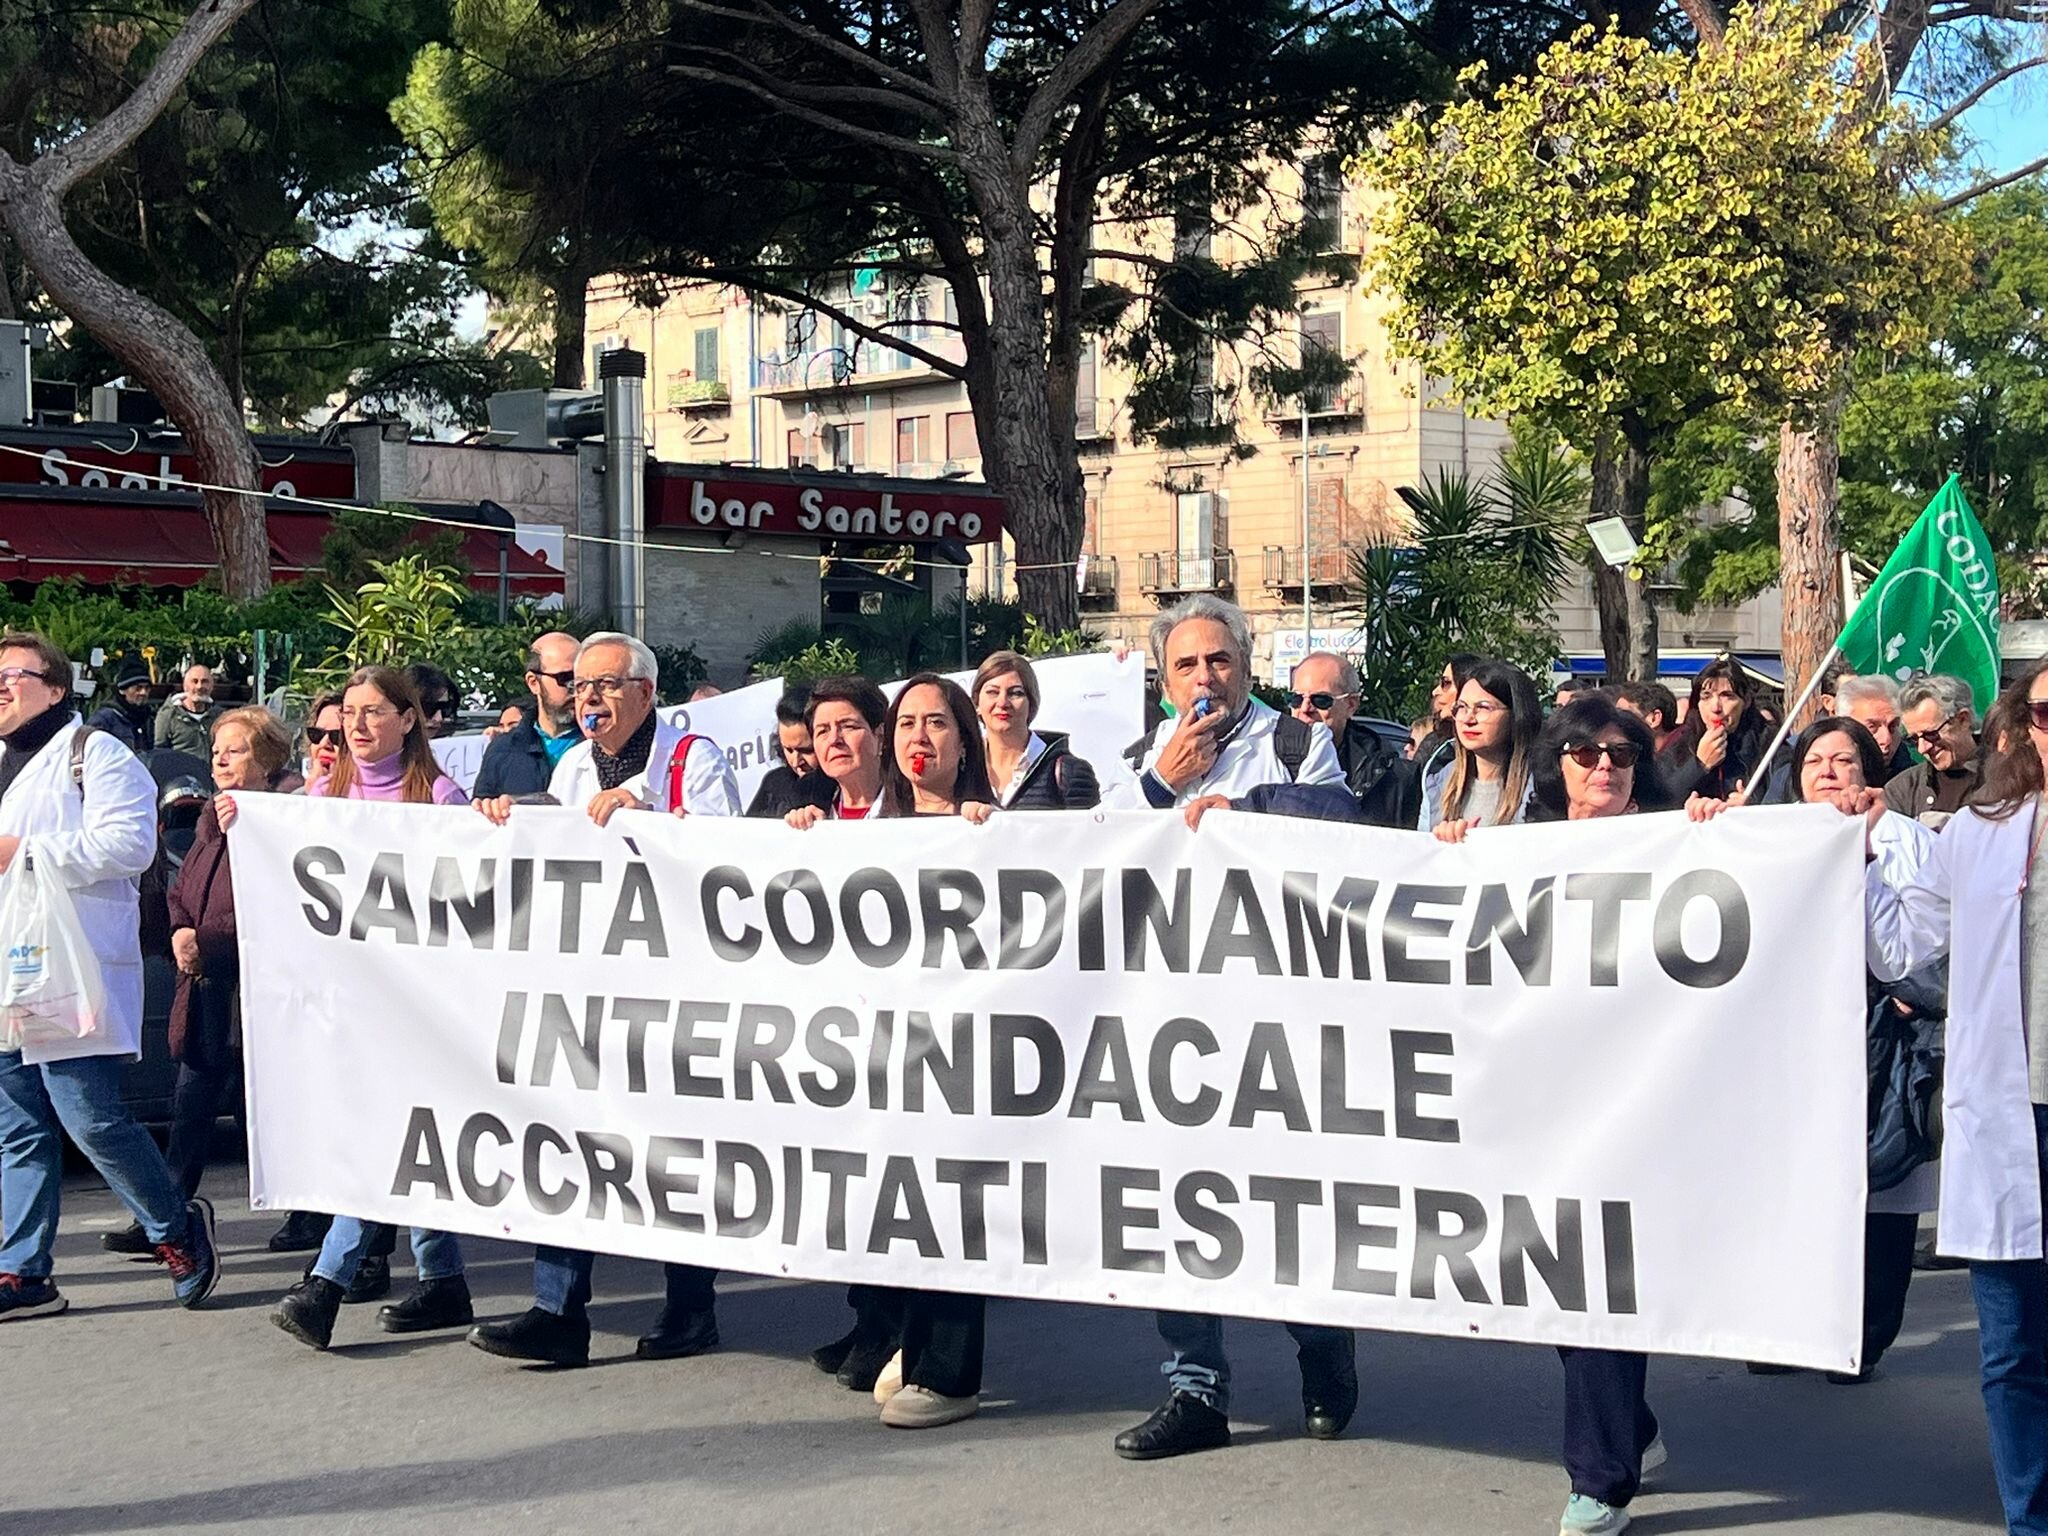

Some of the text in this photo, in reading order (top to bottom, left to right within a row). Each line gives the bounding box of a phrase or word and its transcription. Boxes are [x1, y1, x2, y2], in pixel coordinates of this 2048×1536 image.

[40, 449, 297, 497] Santo
[690, 481, 982, 537] bar Santoro
[1937, 510, 2001, 645] CODAC
[292, 836, 1751, 989] SANITÀ COORDINAMENTO
[496, 991, 1461, 1143] INTERSINDACALE
[390, 1106, 1638, 1314] ACCREDITATI ESTERNI
